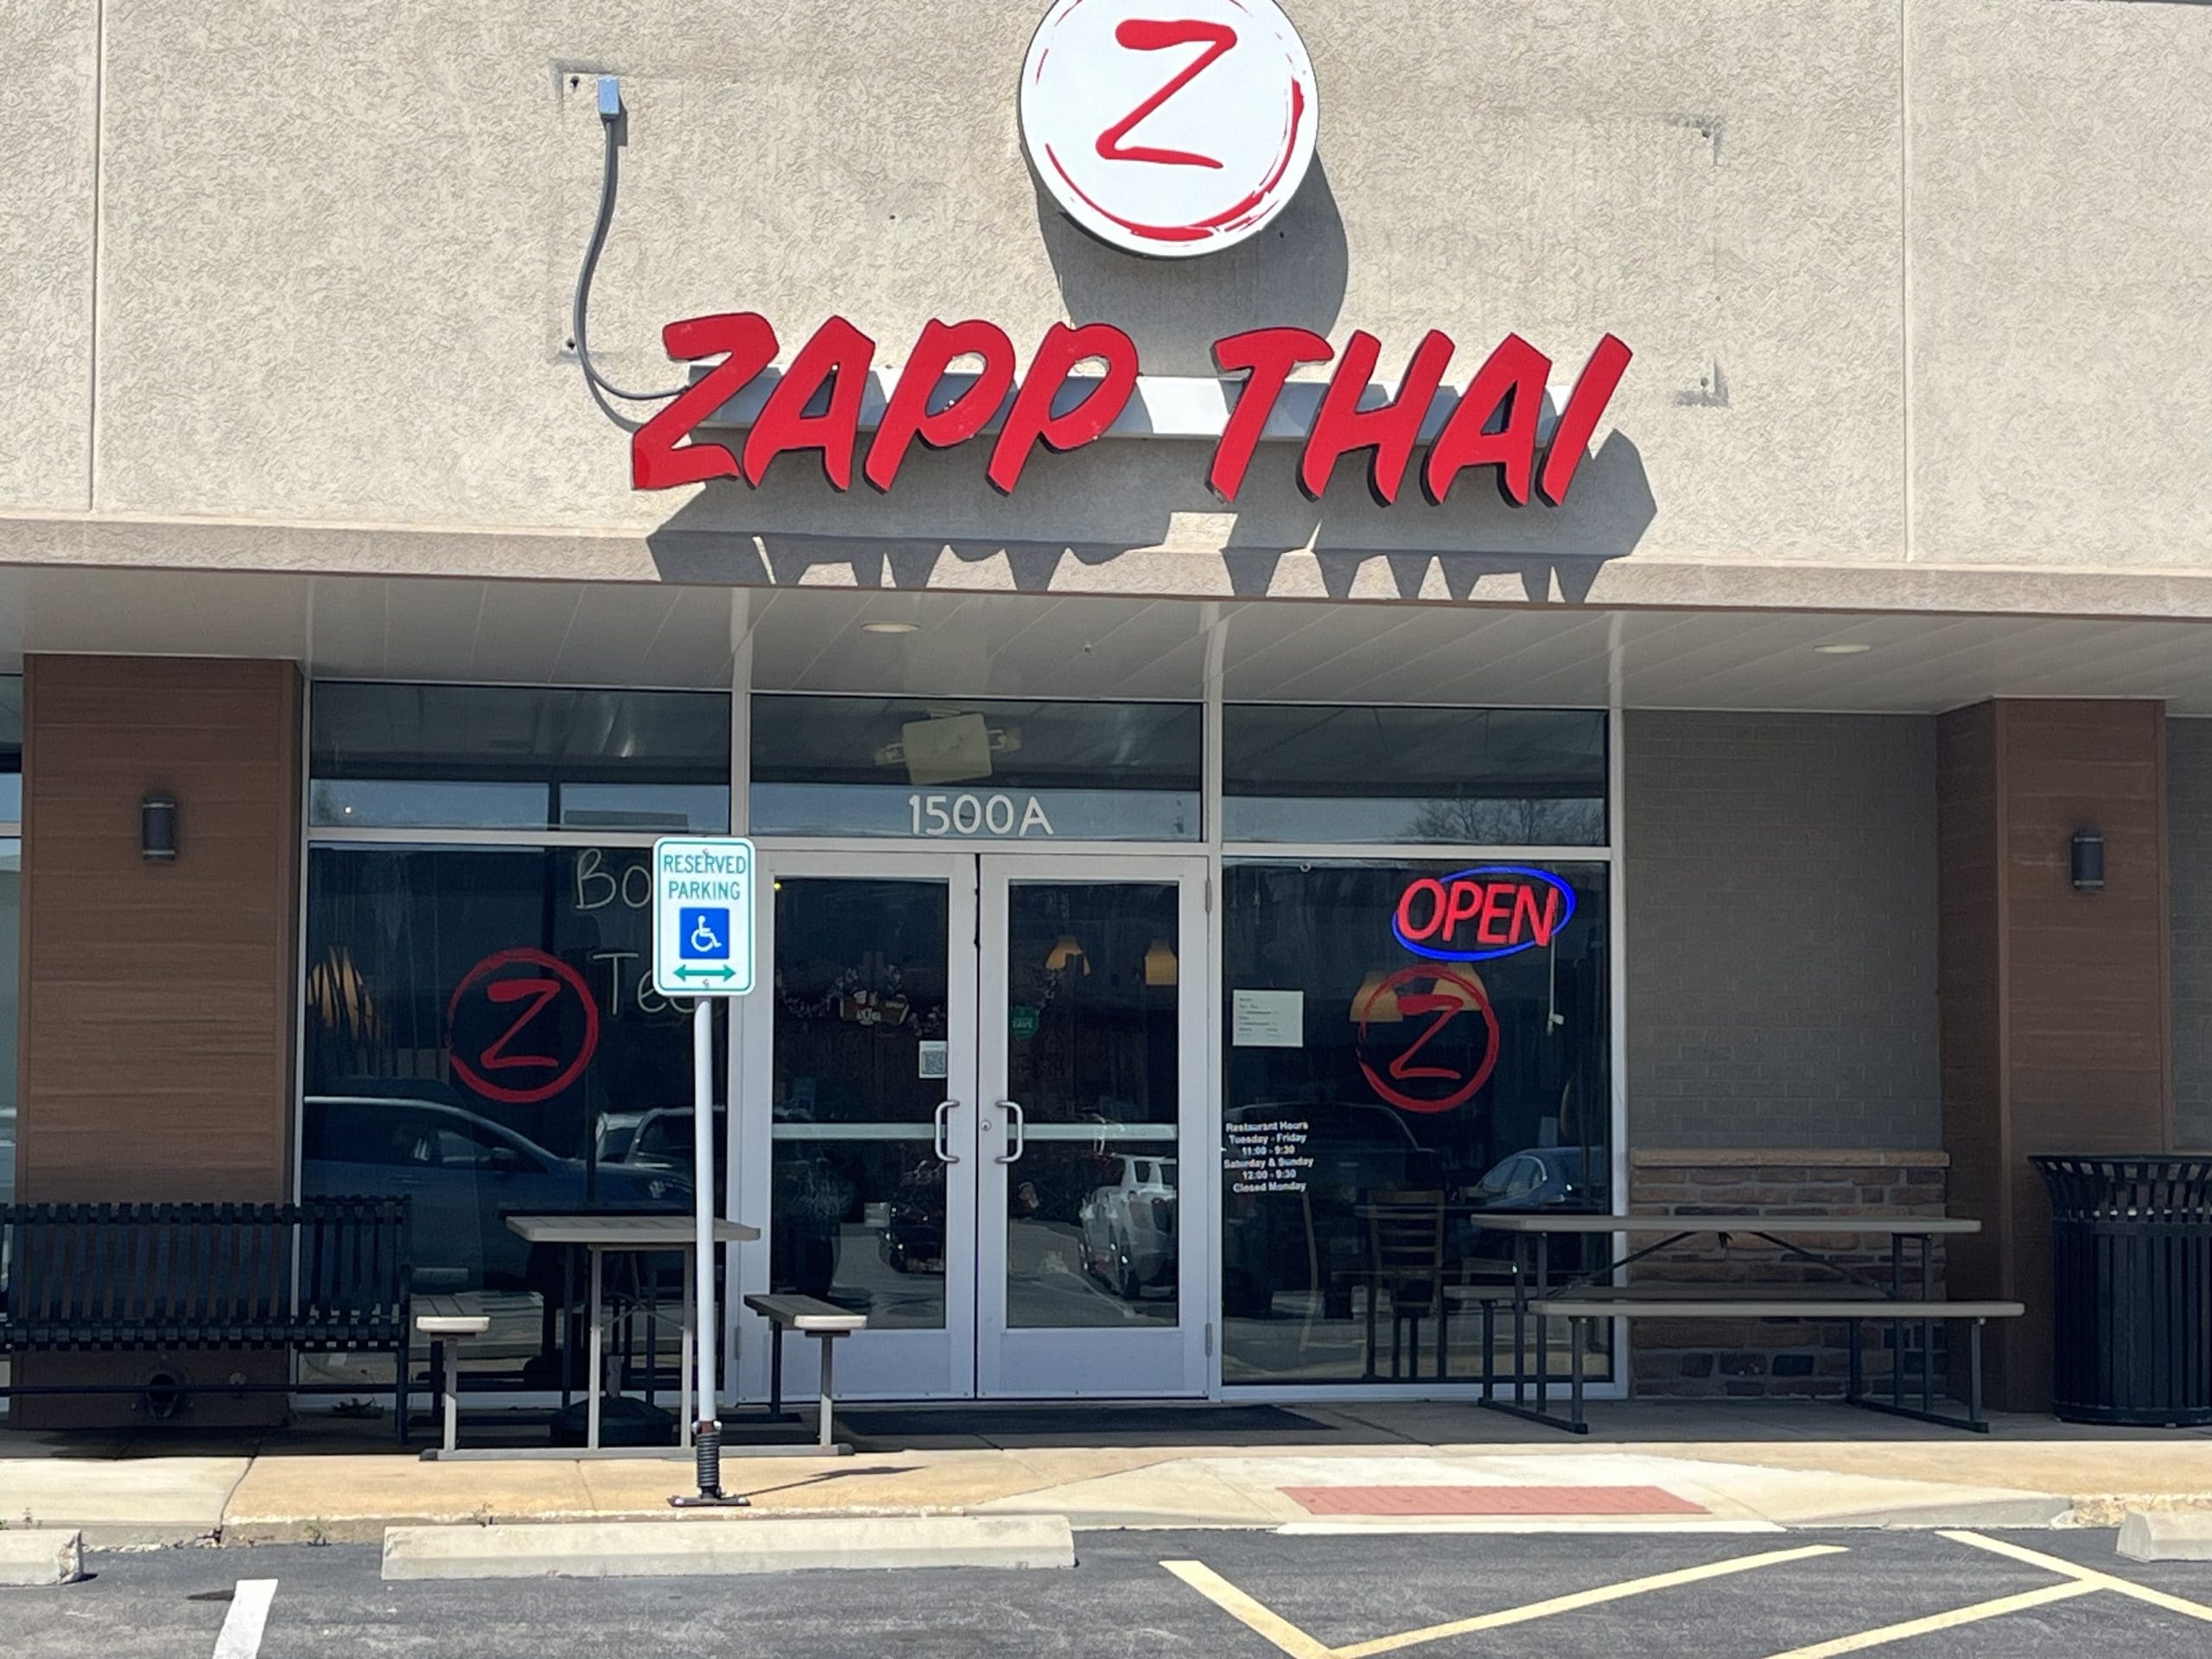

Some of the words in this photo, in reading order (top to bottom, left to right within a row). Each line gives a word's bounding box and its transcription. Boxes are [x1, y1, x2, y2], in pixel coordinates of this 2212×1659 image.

[1096, 20, 1237, 168] Z
[632, 313, 1140, 490] ZAPP
[1210, 327, 1632, 504] THAI
[908, 794, 1054, 836] 1500A
[575, 848, 652, 909] Bo
[663, 854, 747, 874] RESERVED
[668, 880, 741, 900] PARKING
[1397, 878, 1559, 948] OPEN
[479, 977, 562, 1070] Z
[1389, 994, 1464, 1081] Z
[1225, 1122, 1278, 1132] Restaurant
[1280, 1121, 1308, 1130] Hours
[1229, 1134, 1268, 1144] Tuesday
[1276, 1132, 1306, 1143] Friday
[1224, 1159, 1266, 1168] Saturday
[1268, 1157, 1275, 1166] &
[1278, 1156, 1313, 1167] Sunday
[1232, 1182, 1266, 1192] Closed
[1268, 1181, 1306, 1192] Monday
